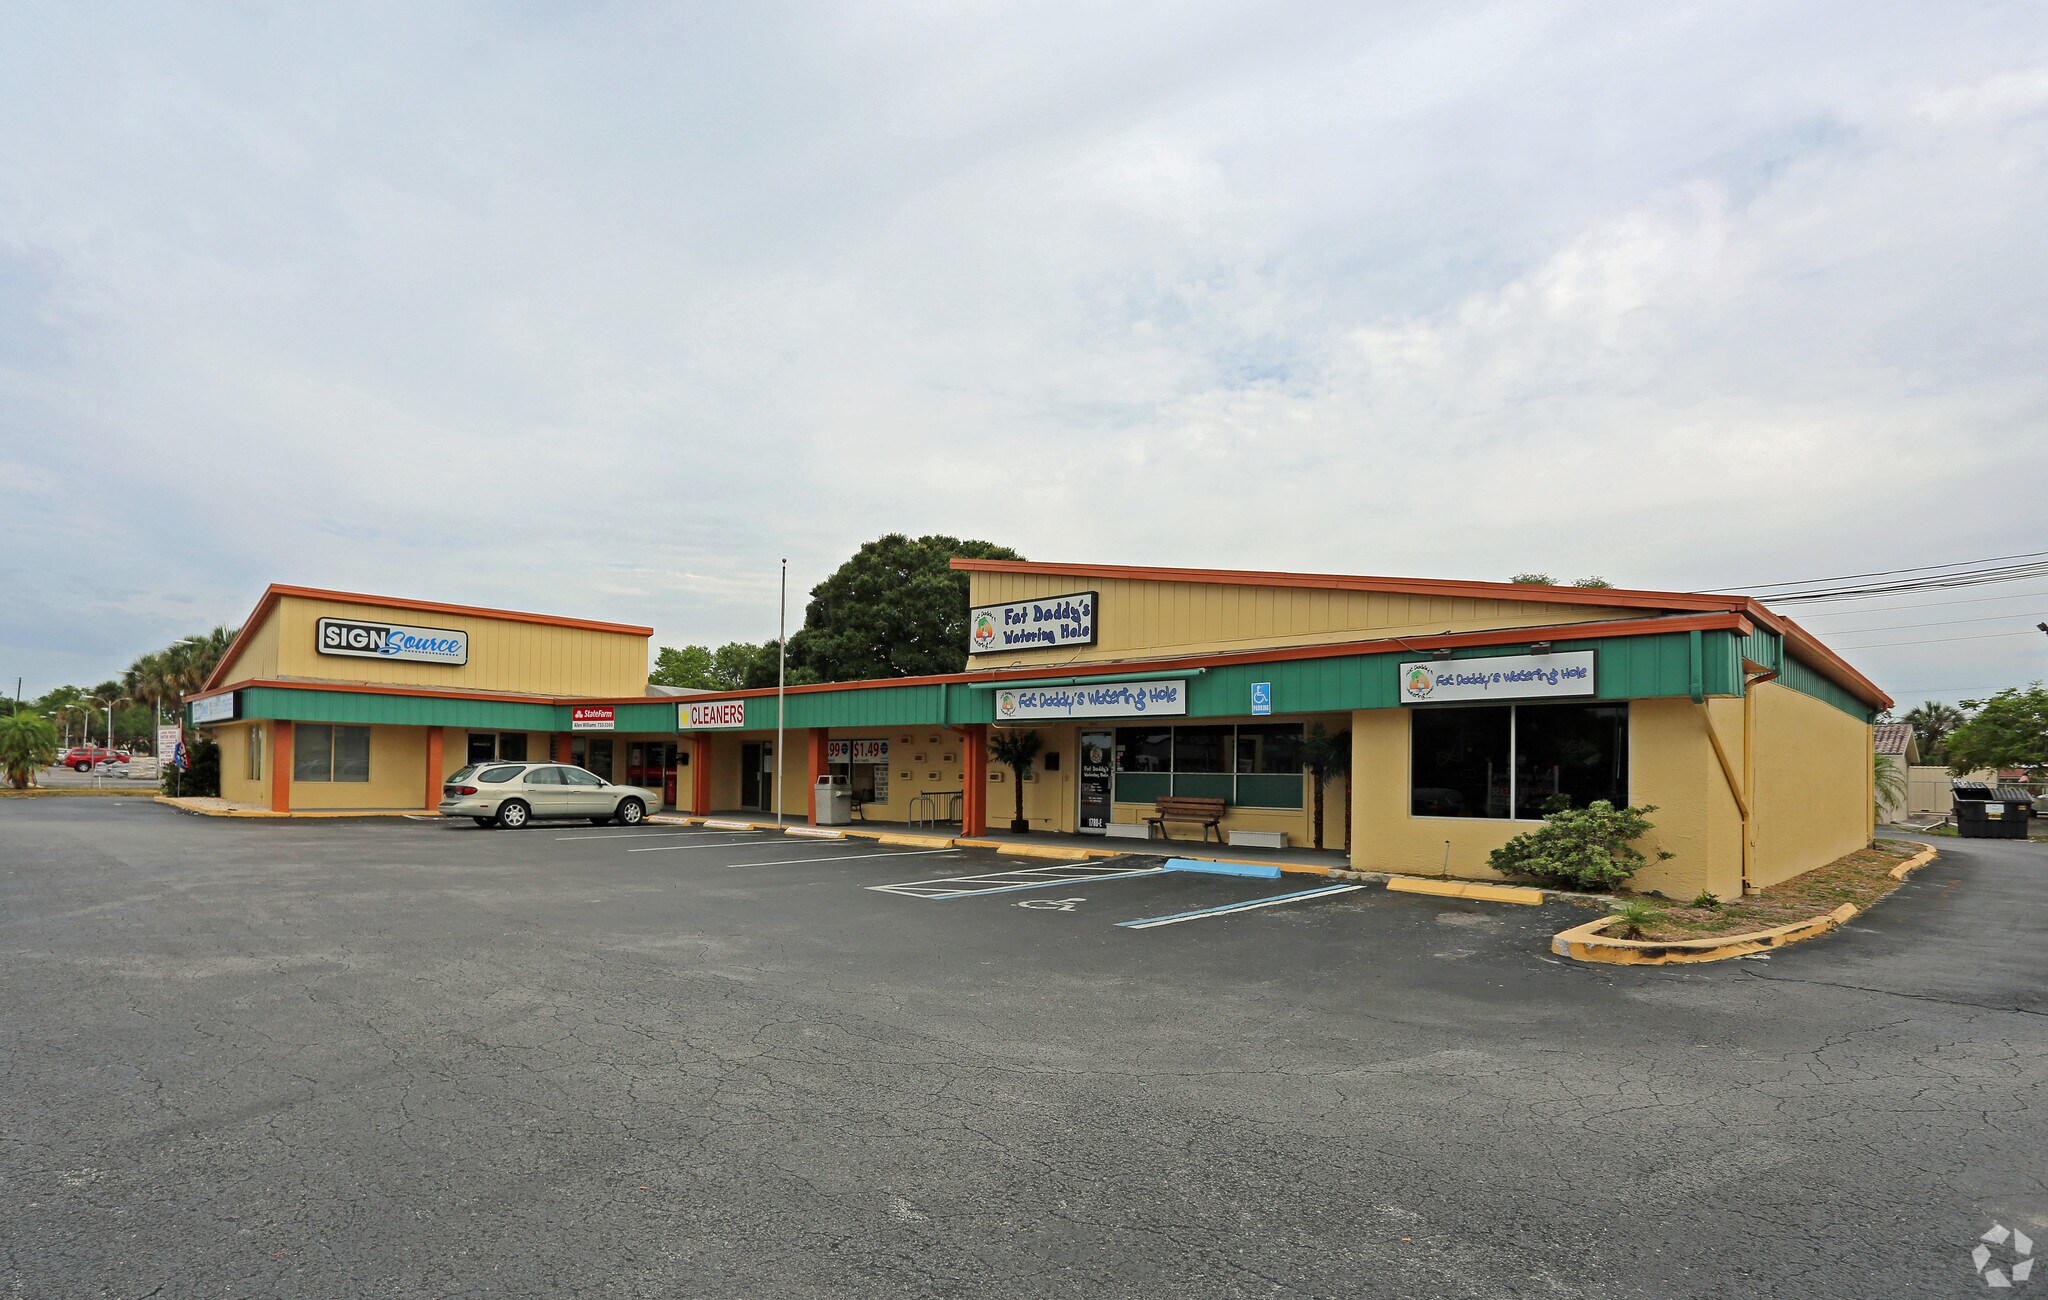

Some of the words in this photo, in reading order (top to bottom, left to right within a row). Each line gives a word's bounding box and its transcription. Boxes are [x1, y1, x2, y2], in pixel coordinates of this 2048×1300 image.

[1004, 607, 1028, 625] Fat
[1032, 599, 1091, 624] Daddy's
[325, 626, 386, 649] SIGN
[377, 631, 463, 655] Source
[1003, 627, 1056, 644] Watering
[1060, 623, 1090, 639] Hole
[1435, 673, 1455, 687] Fat
[1456, 672, 1501, 690] Daddy's
[1503, 668, 1559, 686] Watering
[1561, 665, 1588, 680] Hole
[1018, 692, 1037, 708] Fat
[1039, 691, 1086, 715] Daddy's
[1088, 686, 1146, 711] Watering
[1149, 685, 1178, 704] Hole
[691, 704, 744, 725] CLEANERS
[854, 741, 879, 758] $1.49
